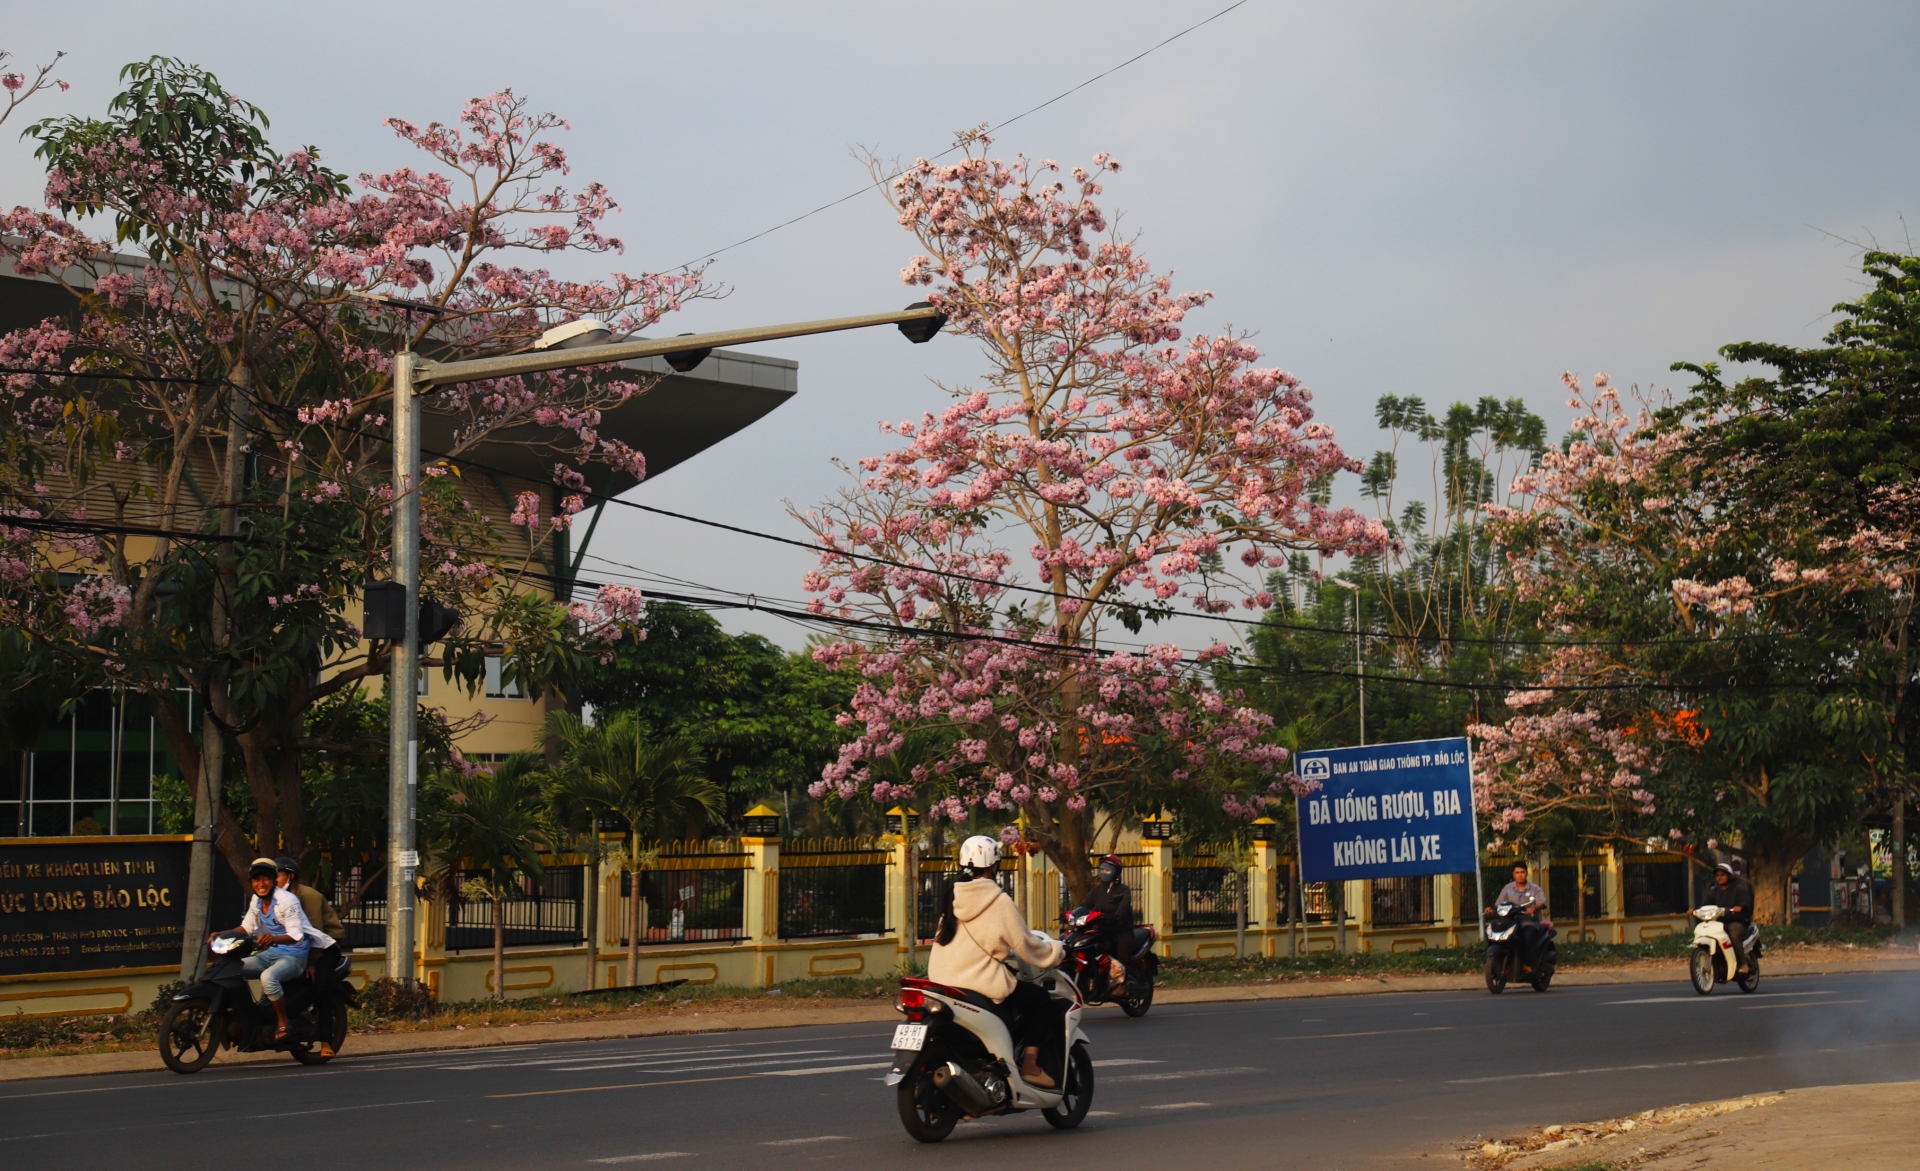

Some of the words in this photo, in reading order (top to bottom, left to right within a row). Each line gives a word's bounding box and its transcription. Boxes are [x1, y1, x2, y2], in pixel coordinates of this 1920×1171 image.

[1333, 762, 1347, 774] BAN
[1349, 761, 1358, 773] AN
[1359, 757, 1377, 772] TOÀN
[1379, 757, 1395, 771] GIAO
[1397, 754, 1420, 769] THÔNG
[1422, 755, 1433, 767] TP.
[1434, 750, 1449, 766] BẢO
[1451, 749, 1465, 767] LỘC
[1309, 794, 1331, 825] ĐÃ
[1334, 788, 1378, 824] UỐNG
[1381, 790, 1429, 824] RƯỢU,
[1433, 789, 1462, 816] BIA
[1333, 836, 1387, 867] KHÔNG
[1391, 831, 1416, 863] LÁI
[1420, 834, 1441, 861] XE
[25, 863, 41, 877] XE
[45, 860, 90, 877] KHÁCH
[93, 859, 121, 876] LIÊN
[33, 890, 87, 912] LONG
[93, 884, 131, 909] BẢO
[136, 884, 171, 912] LỘC
